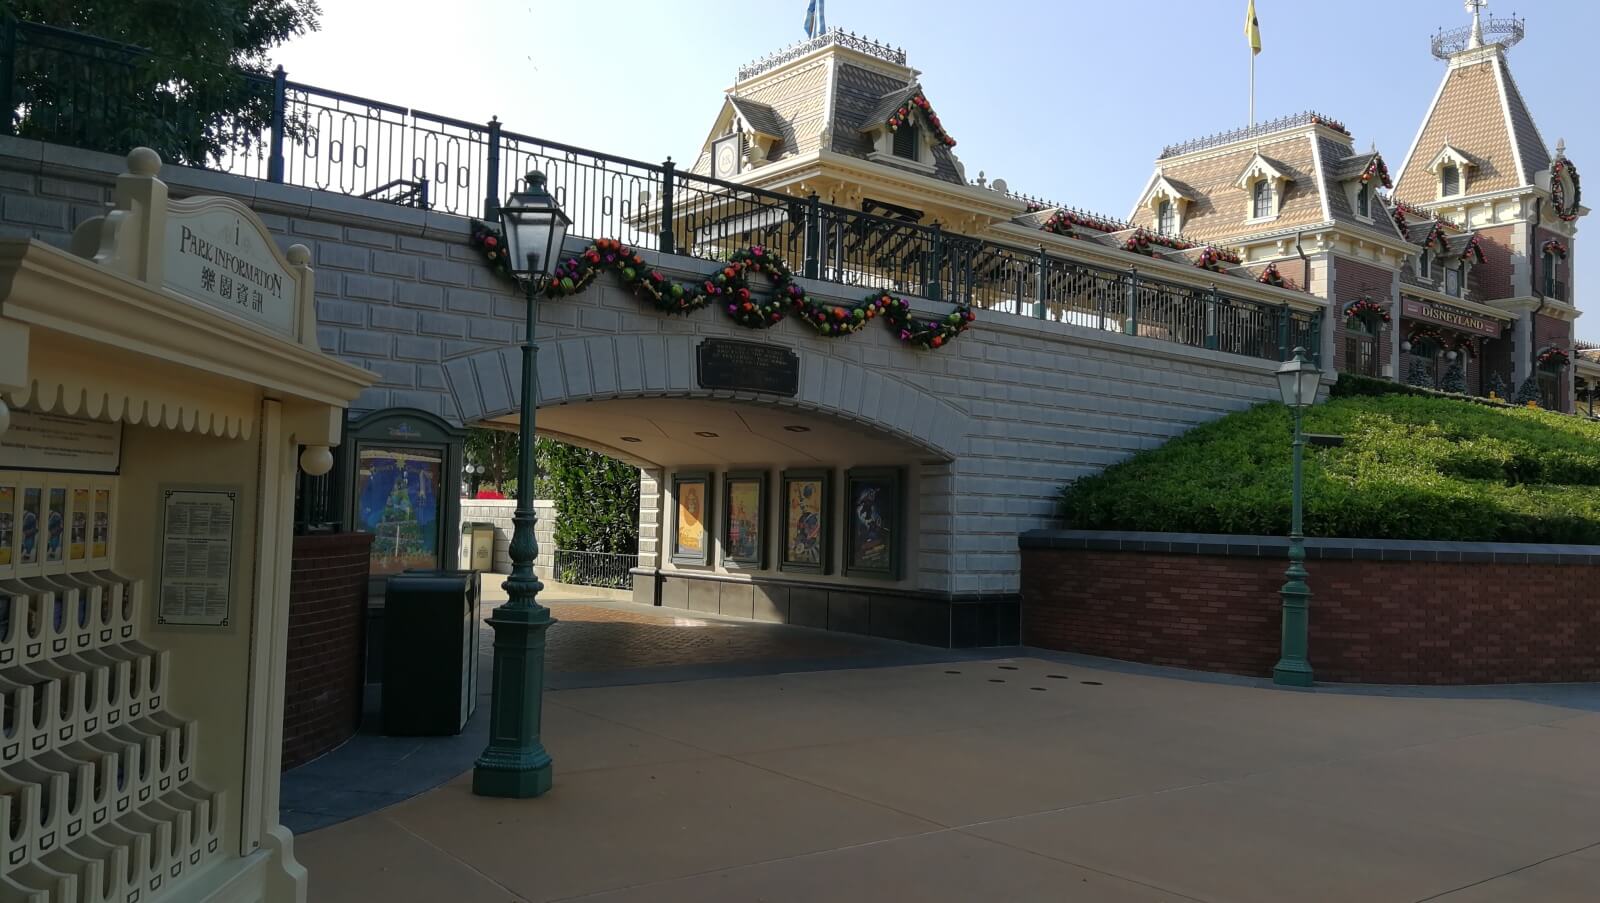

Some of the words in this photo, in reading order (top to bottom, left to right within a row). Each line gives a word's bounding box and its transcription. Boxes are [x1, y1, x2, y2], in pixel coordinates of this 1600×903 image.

[180, 225, 213, 261] PARK
[214, 246, 282, 299] INFORMATION
[201, 266, 263, 313] 樂園資訊
[1422, 306, 1483, 330] DISNEYLAND
